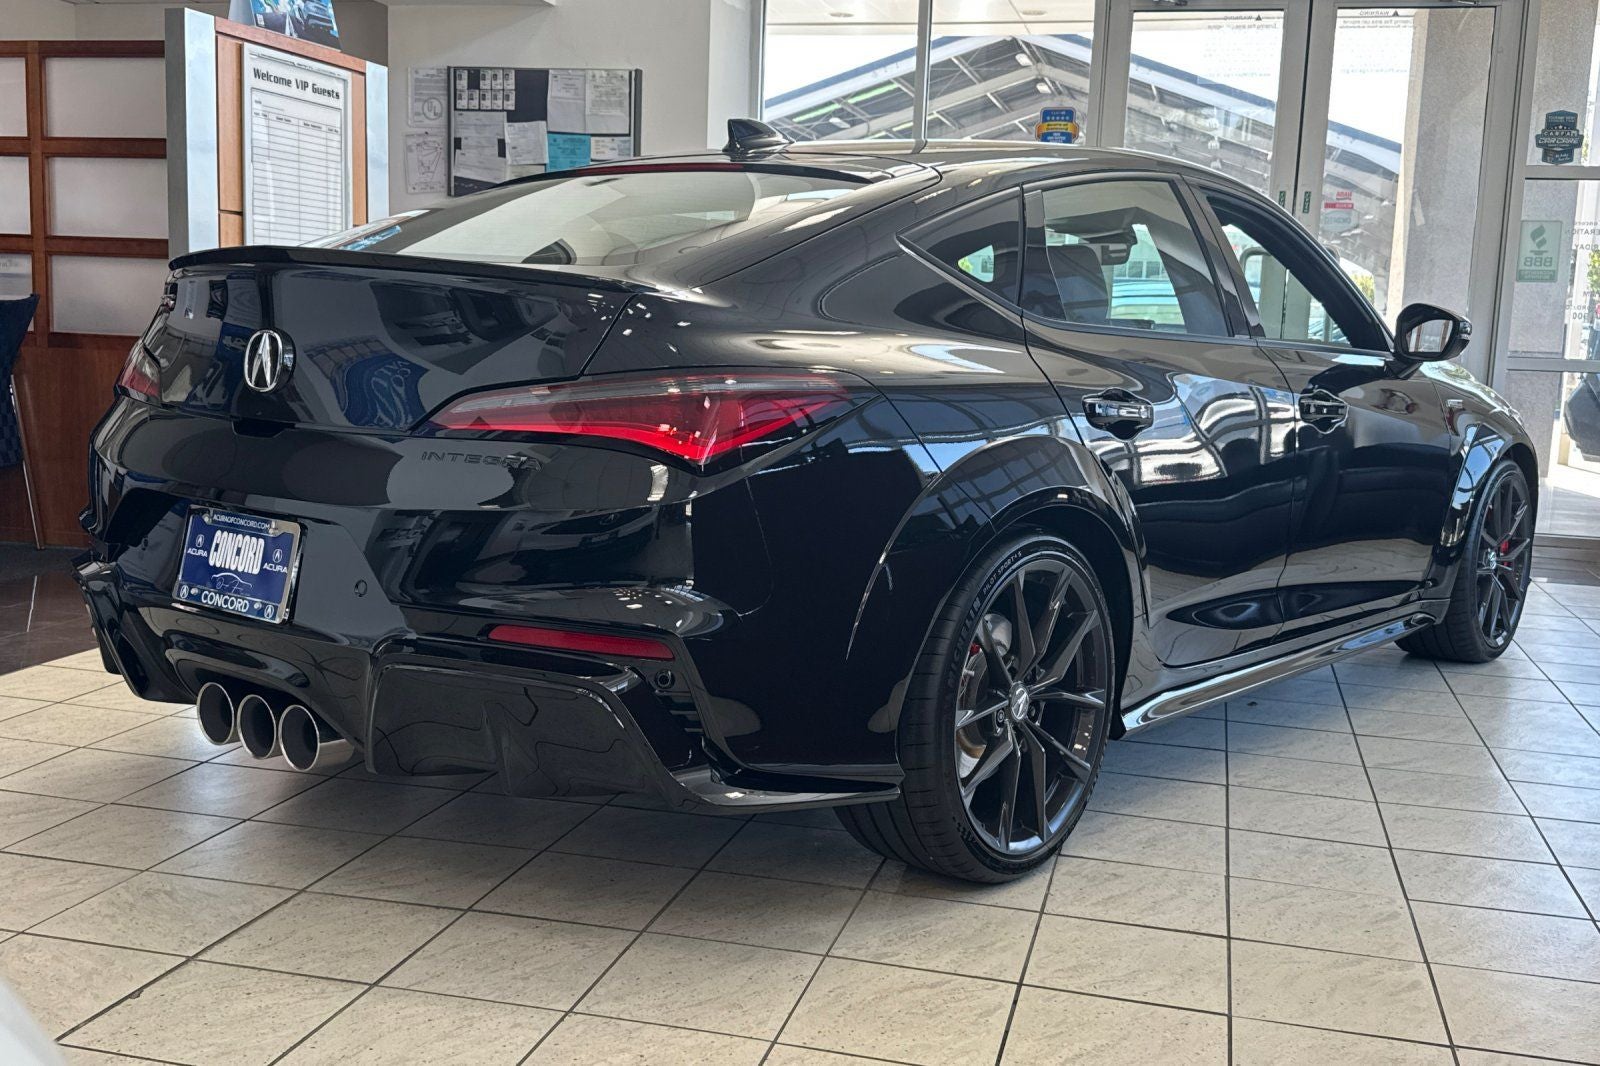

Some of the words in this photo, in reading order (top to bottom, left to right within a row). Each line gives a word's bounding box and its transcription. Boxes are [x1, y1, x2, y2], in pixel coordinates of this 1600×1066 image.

[253, 67, 292, 87] Welcome
[295, 78, 309, 91] VIP
[312, 83, 340, 99] Guests
[421, 451, 543, 472] INTEGRA
[187, 548, 208, 558] ACURA
[208, 529, 265, 575] CONCORD
[262, 562, 288, 574] ACURA
[983, 574, 998, 596] PILOT
[998, 556, 1015, 575] SPORT
[201, 590, 250, 612] CONCORD
